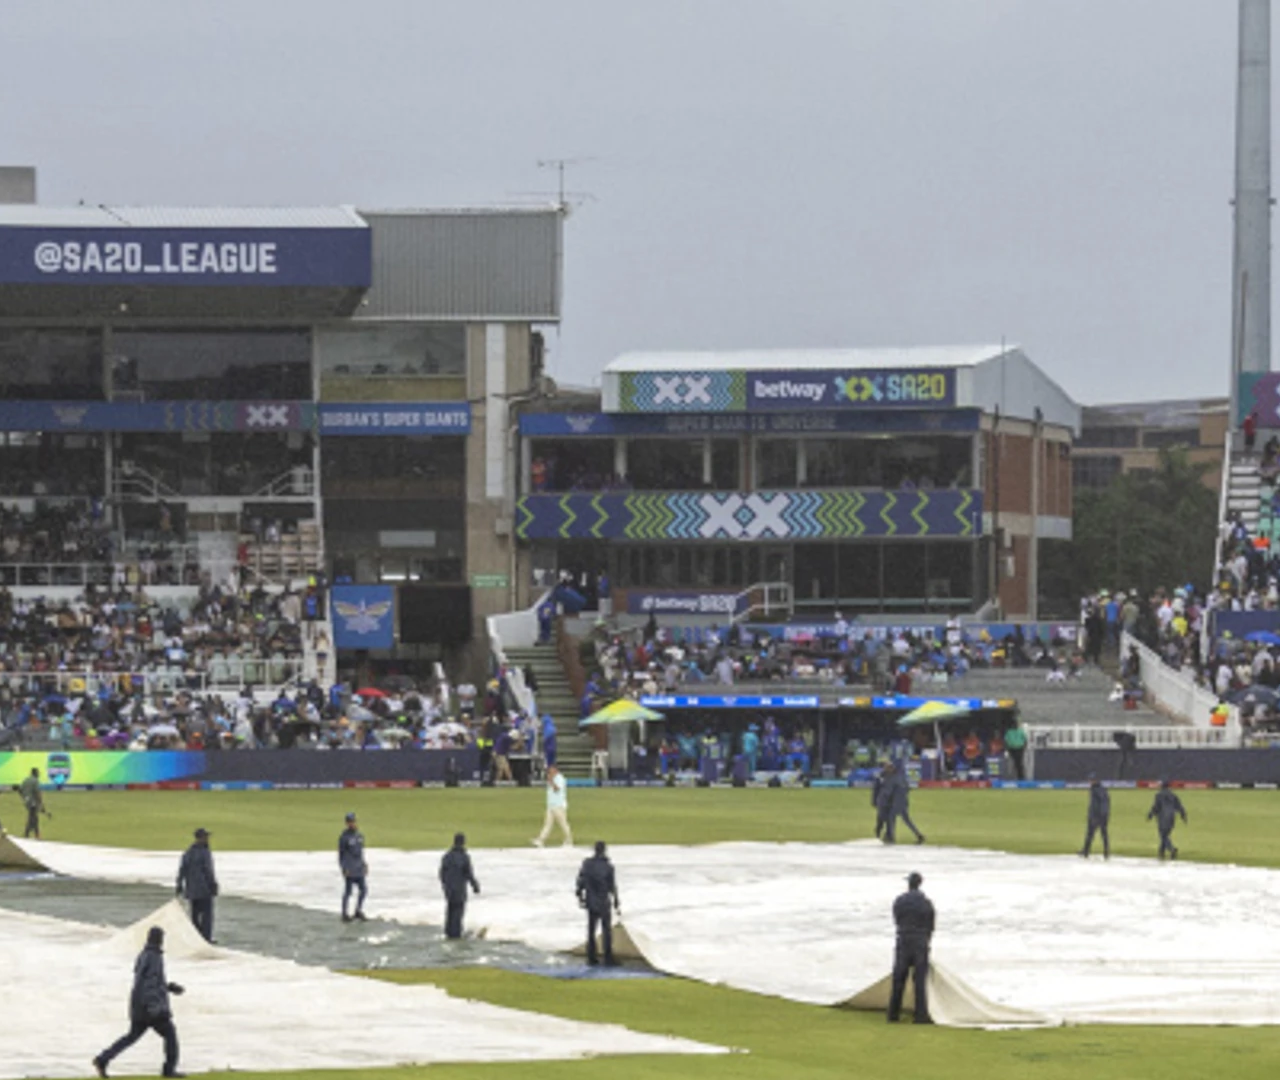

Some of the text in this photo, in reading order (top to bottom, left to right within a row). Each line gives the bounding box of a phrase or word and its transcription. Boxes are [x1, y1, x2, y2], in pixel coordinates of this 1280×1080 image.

[35, 242, 277, 273] @SA20_LEAGUE
[754, 379, 826, 400] betway
[887, 374, 945, 400] SA20
[322, 411, 468, 427] DURBAN'S SUPER GIANTS
